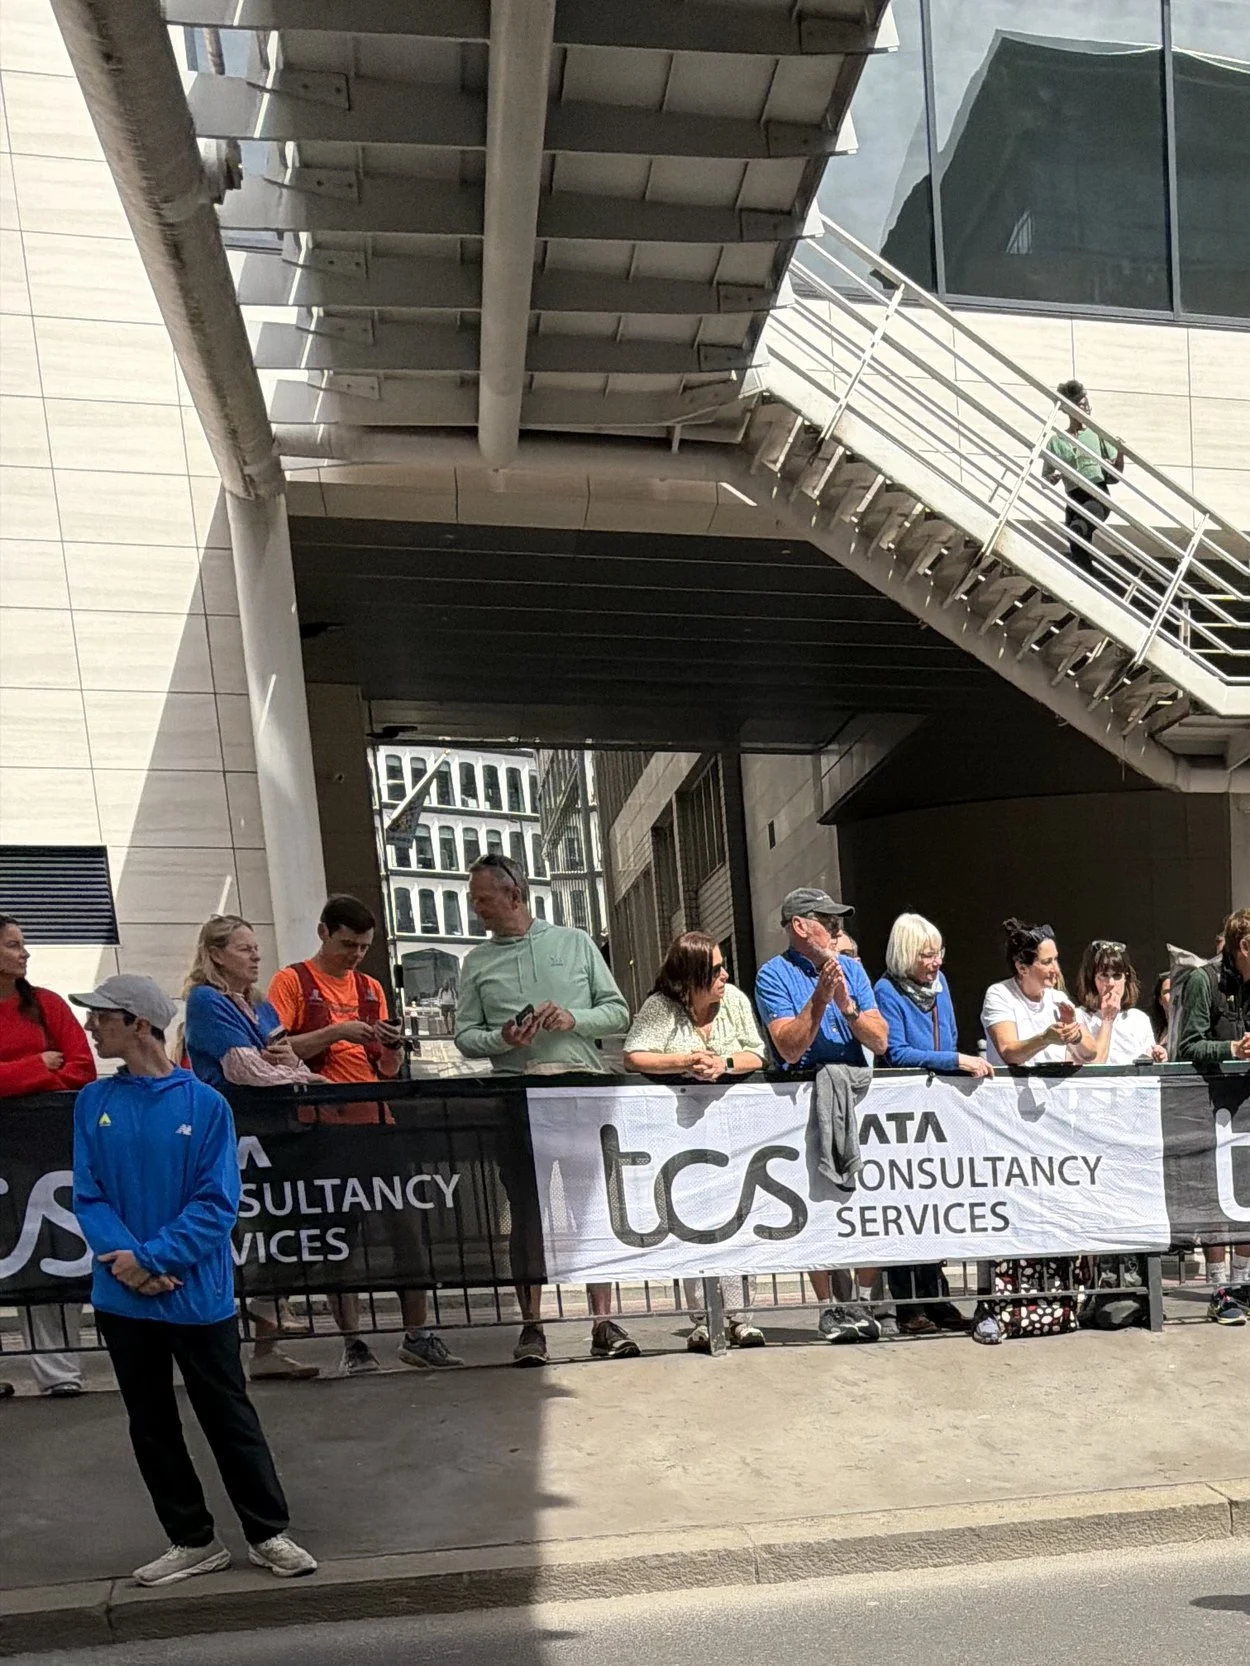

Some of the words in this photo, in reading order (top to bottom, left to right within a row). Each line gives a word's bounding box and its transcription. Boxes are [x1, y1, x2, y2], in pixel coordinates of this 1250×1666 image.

[858, 1111, 948, 1145] ATA
[600, 1123, 808, 1249] tcs
[858, 1155, 1103, 1192] ONSULTANCY
[239, 1173, 461, 1218] SULTANCY
[836, 1201, 1010, 1238] SERVICES
[231, 1227, 350, 1266] VICES
